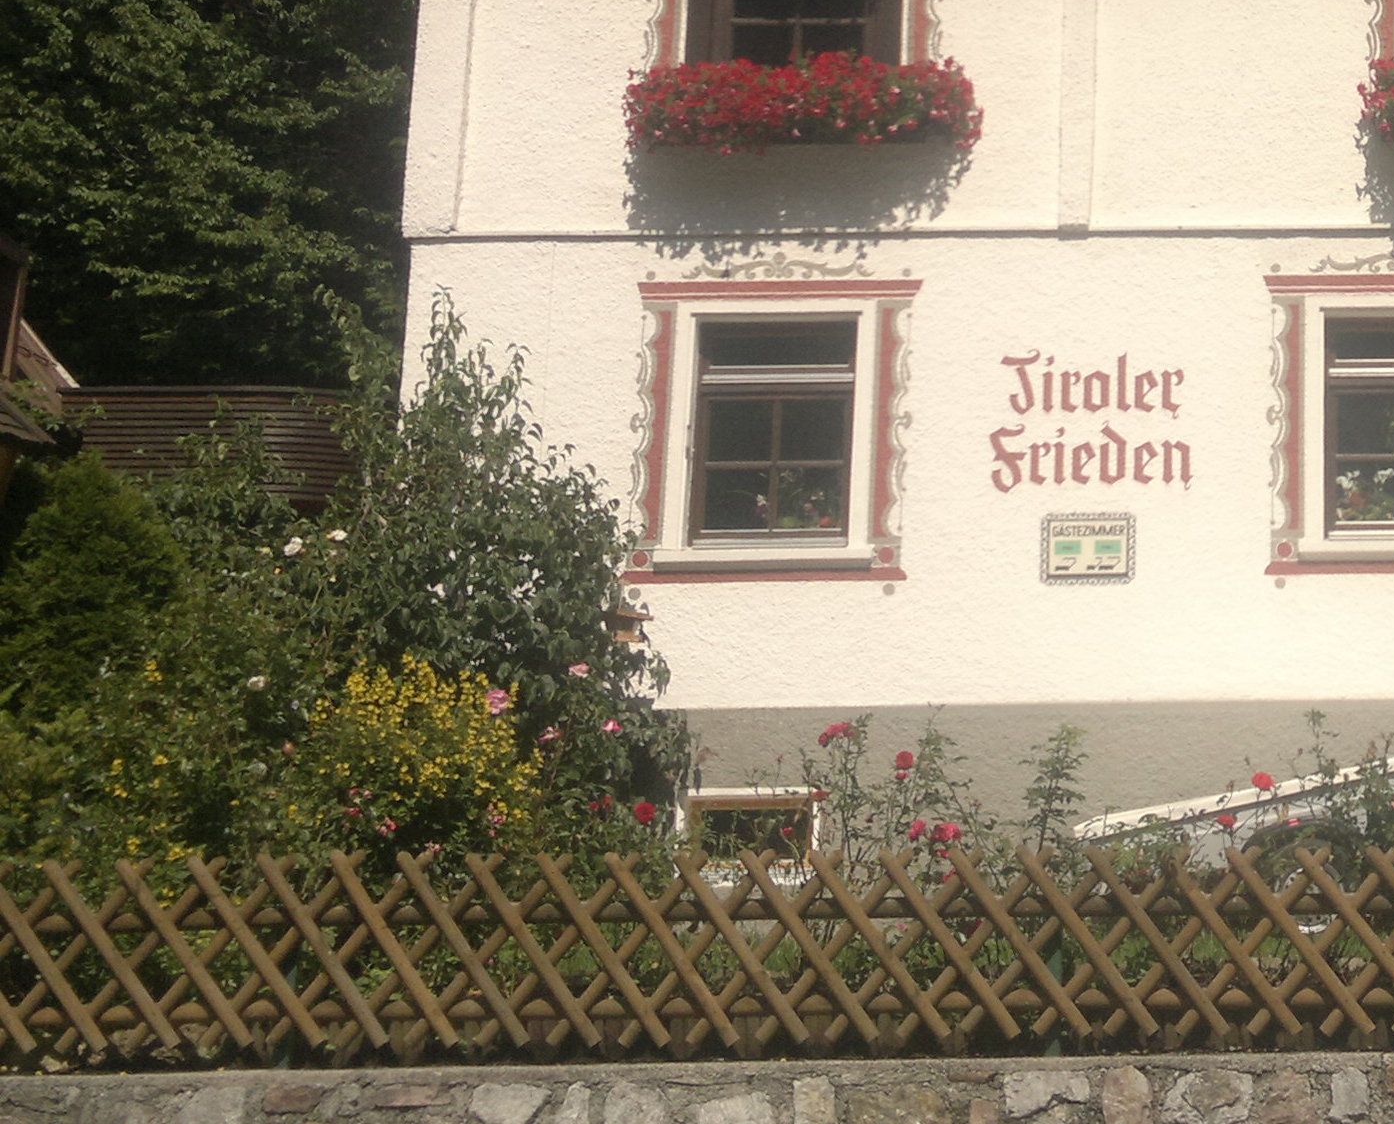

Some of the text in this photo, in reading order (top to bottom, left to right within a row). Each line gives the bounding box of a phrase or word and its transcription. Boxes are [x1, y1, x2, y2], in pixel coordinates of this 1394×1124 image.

[1000, 349, 1184, 419] Tiroler
[989, 421, 1194, 493] Frieden
[1052, 524, 1126, 538] GÄSTEZIMMER
